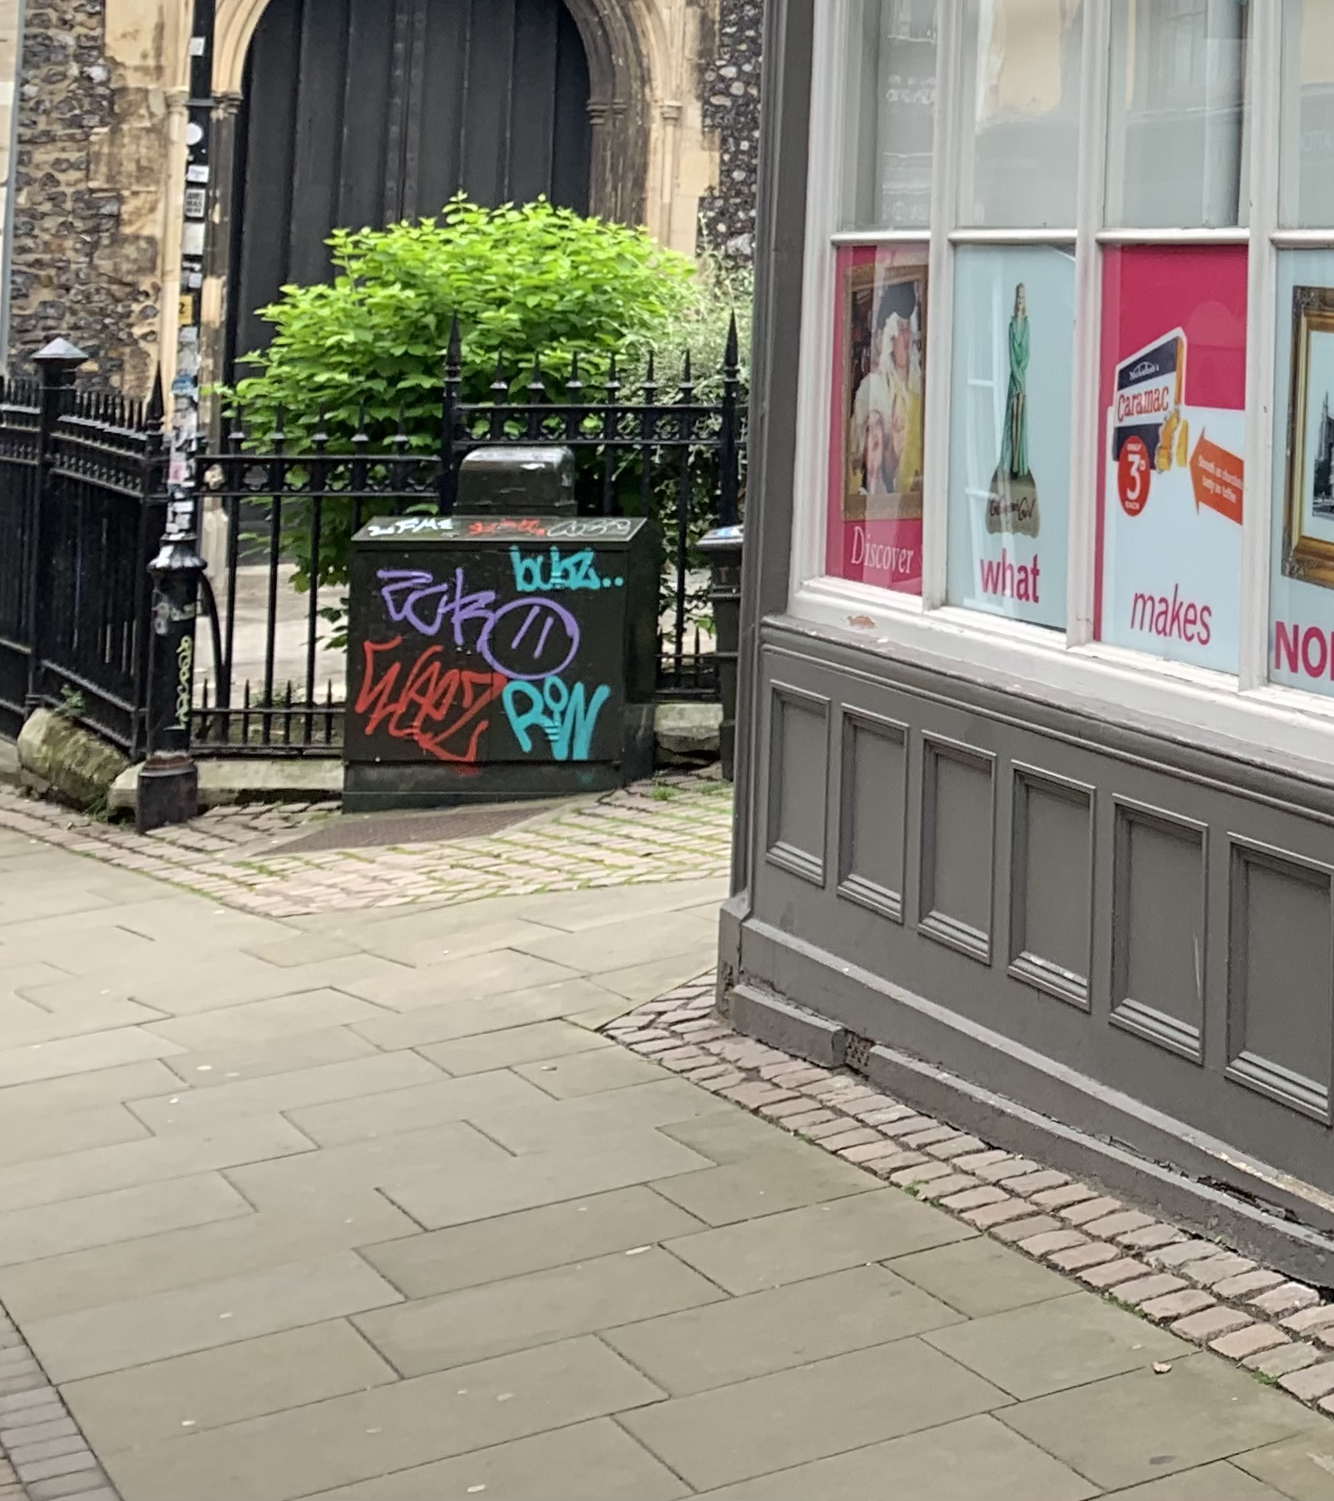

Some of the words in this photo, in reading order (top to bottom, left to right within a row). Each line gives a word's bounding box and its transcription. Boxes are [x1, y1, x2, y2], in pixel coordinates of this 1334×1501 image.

[1117, 386, 1169, 423] Caramac
[850, 524, 915, 576] Discover
[980, 547, 1041, 604] what
[1130, 583, 1213, 646] makes
